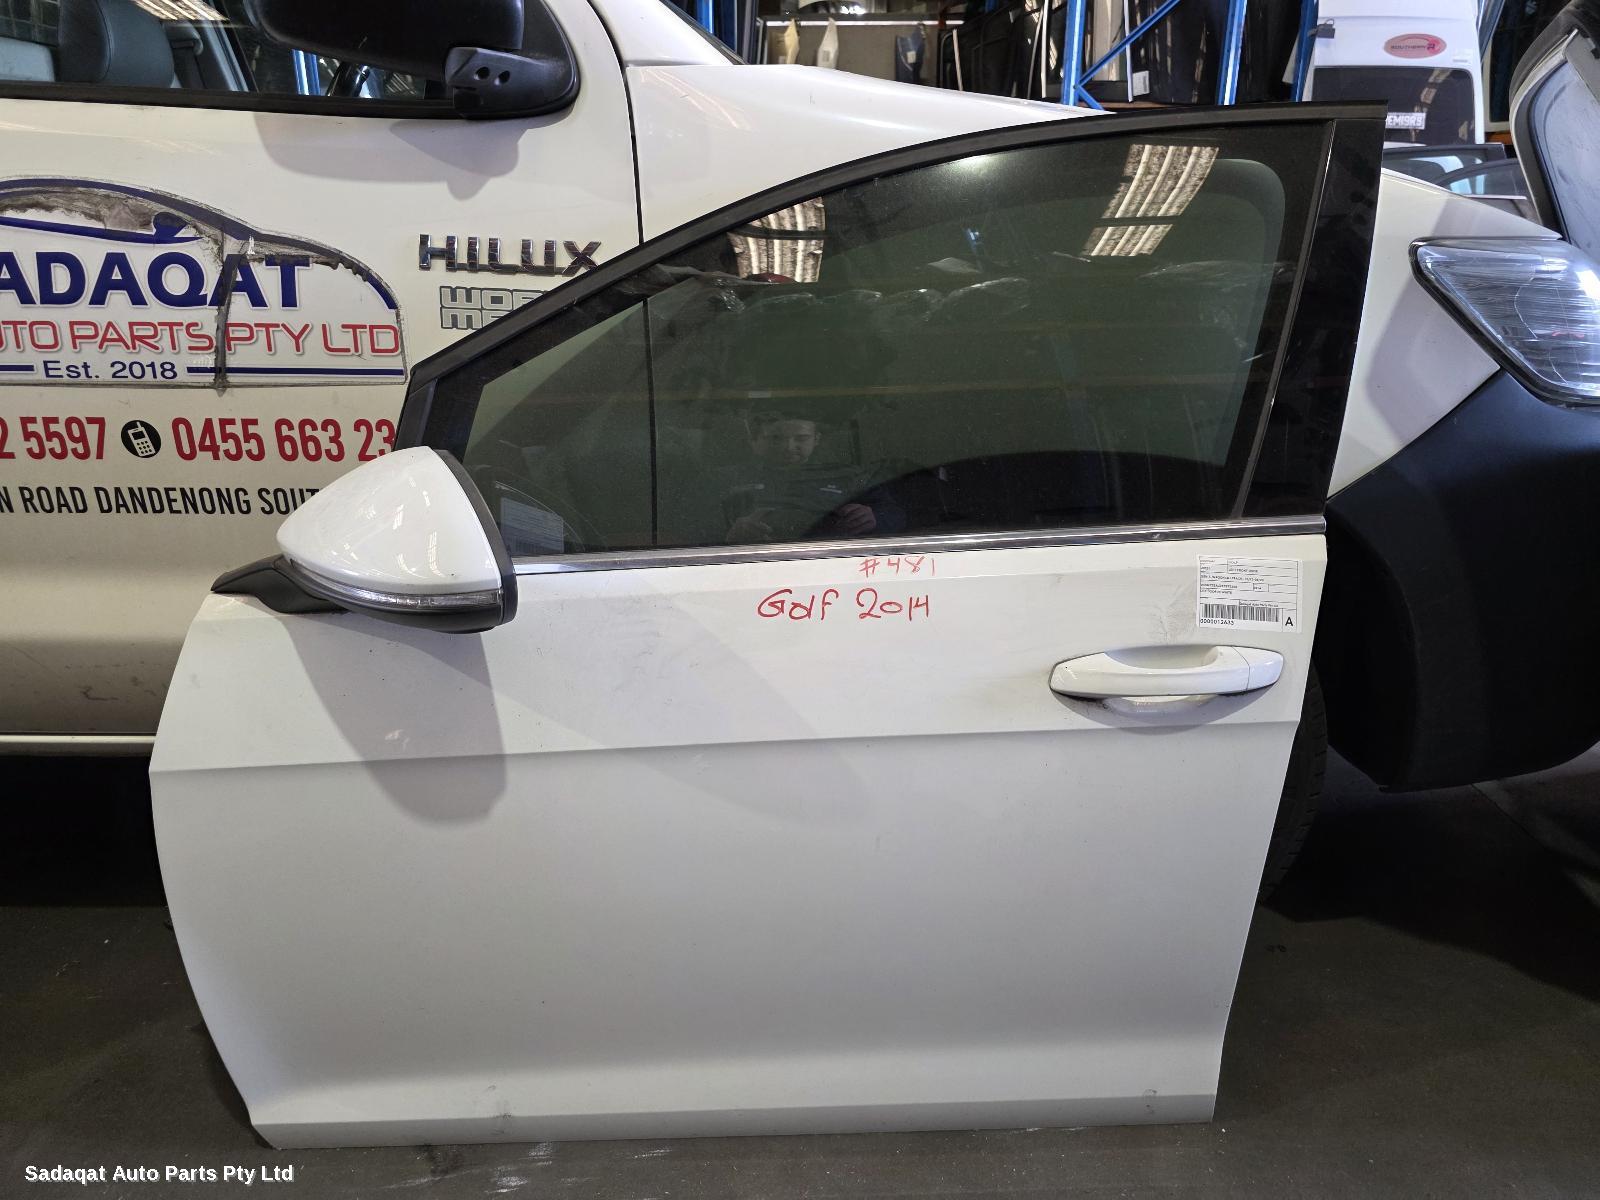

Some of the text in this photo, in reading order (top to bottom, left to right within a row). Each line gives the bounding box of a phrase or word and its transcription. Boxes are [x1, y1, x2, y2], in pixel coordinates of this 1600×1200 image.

[419, 233, 602, 276] HILUX
[0, 251, 311, 309] ADAQAT
[0, 320, 400, 354] TO PARTS PTY LTD
[43, 360, 178, 380] Est. 2018
[19, 416, 107, 460] 5597
[171, 417, 266, 462] 0455
[274, 418, 346, 462] 663
[353, 418, 396, 462] 23
[18, 486, 88, 514] ROAD
[94, 486, 253, 516] DANDENONG
[757, 587, 930, 622] Golf 2014
[1284, 616, 1294, 627] A
